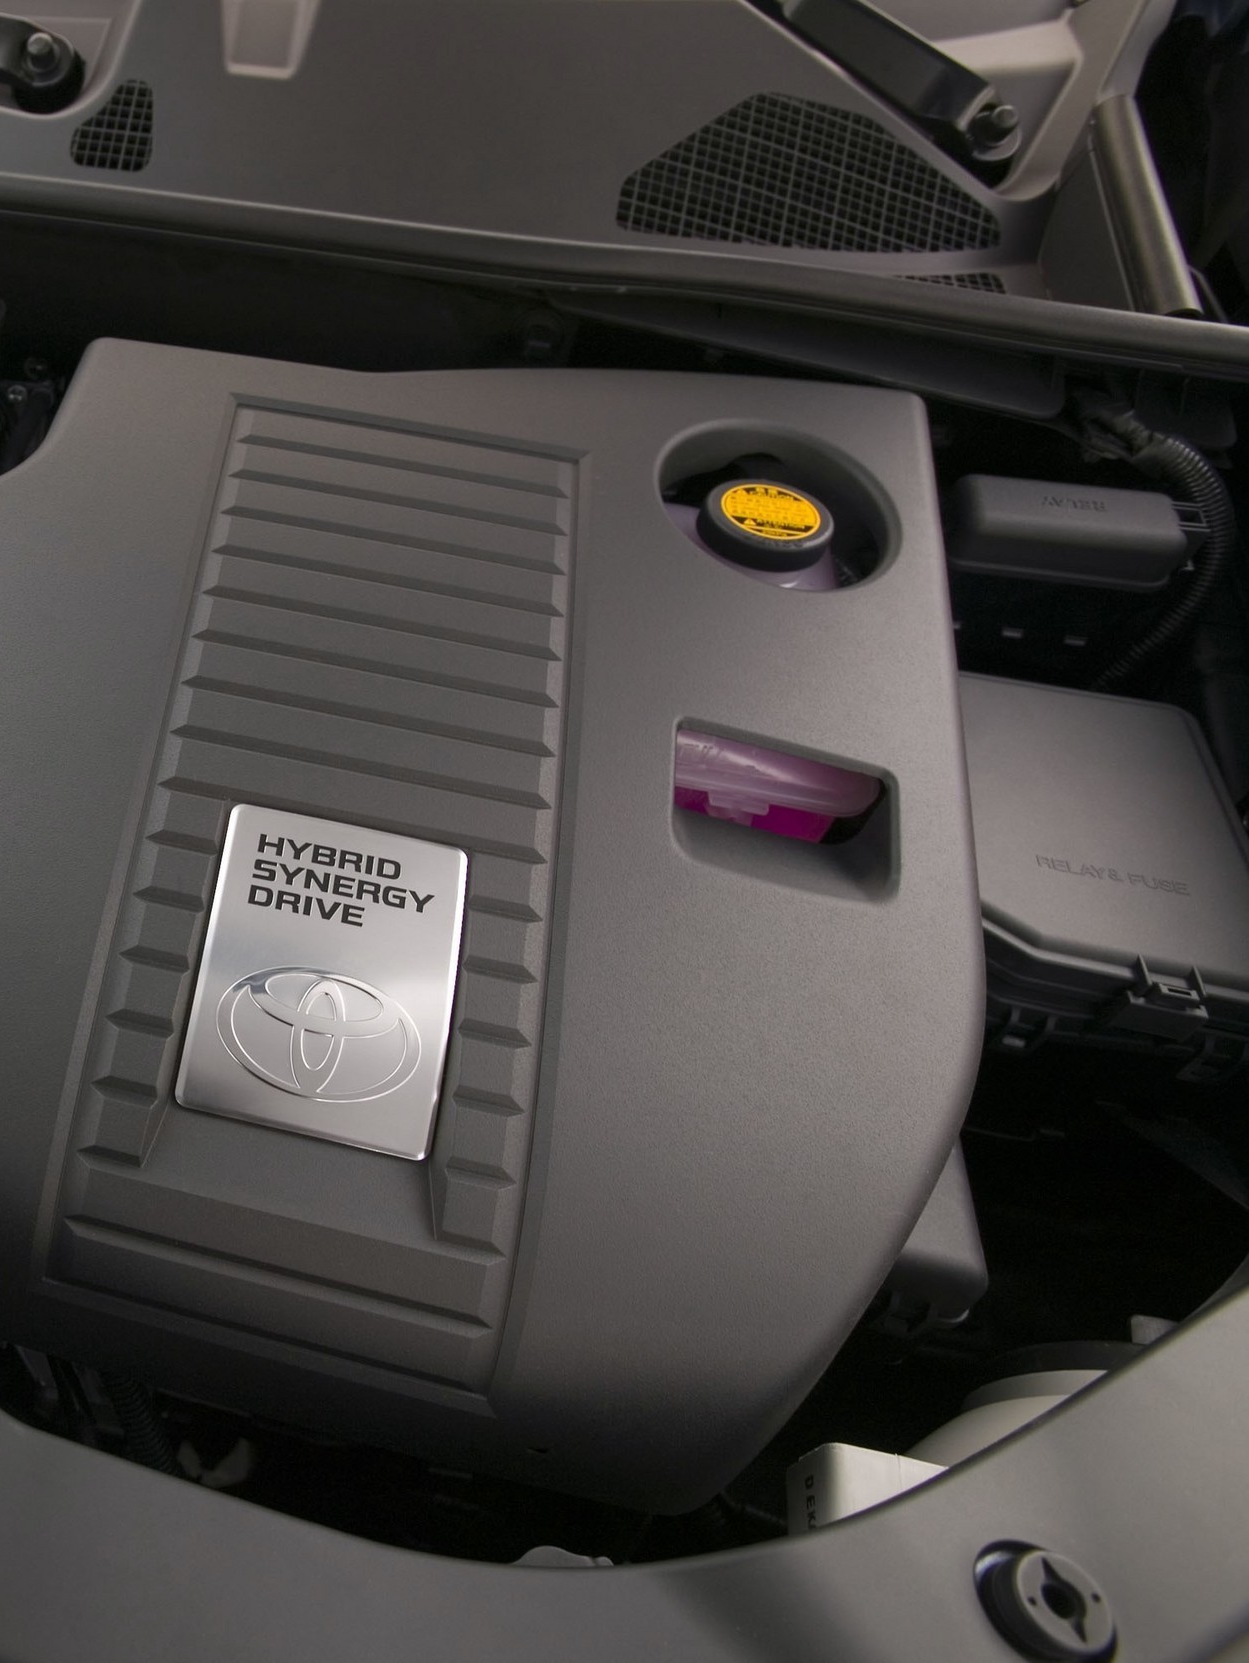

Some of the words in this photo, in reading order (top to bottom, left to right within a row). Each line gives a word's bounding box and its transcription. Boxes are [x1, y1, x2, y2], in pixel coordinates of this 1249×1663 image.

[257, 833, 402, 880] HYBRID
[1036, 855, 1105, 880] RELAY
[1126, 872, 1191, 896] FUSE
[247, 884, 365, 927] DRIVE
[252, 858, 435, 913] SYNERGY
